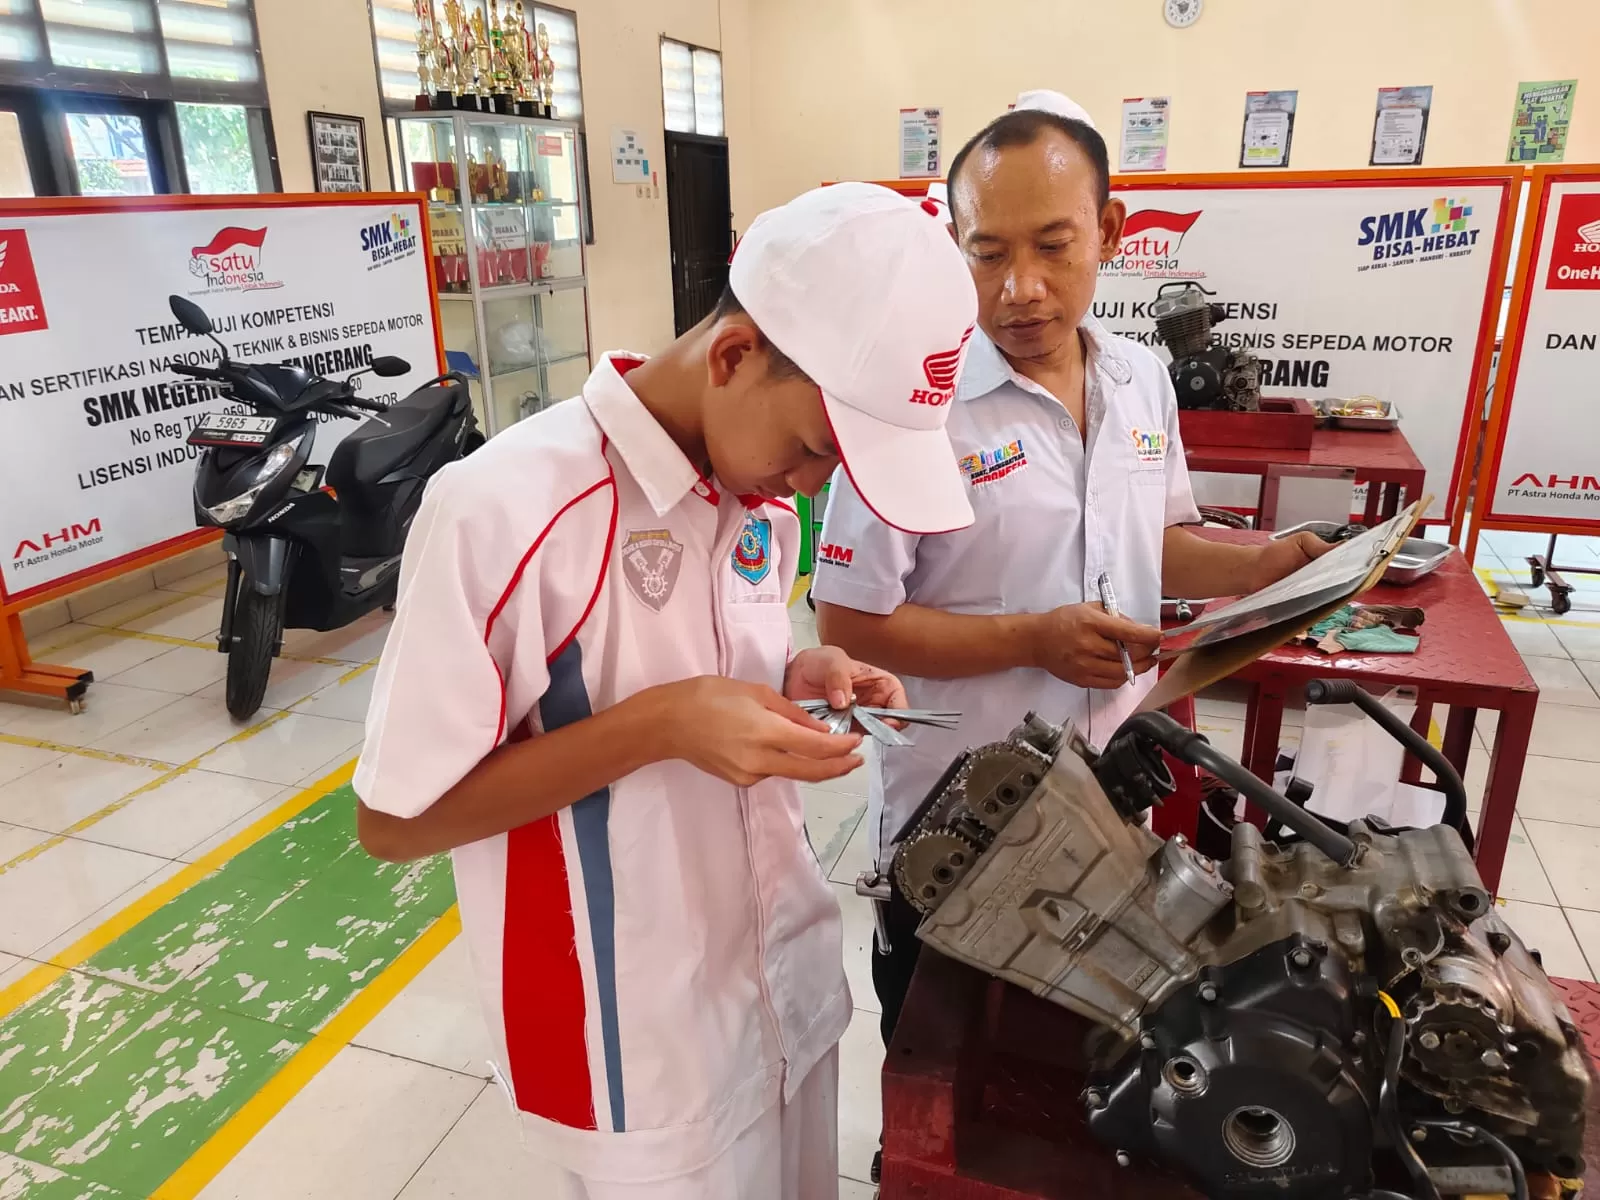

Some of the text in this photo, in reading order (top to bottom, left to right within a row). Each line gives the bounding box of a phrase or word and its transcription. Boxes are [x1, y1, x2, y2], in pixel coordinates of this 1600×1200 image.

[360, 221, 393, 251] SMK
[1357, 207, 1429, 246] SMK
[371, 236, 416, 262] BISA-HEBAT
[1373, 229, 1481, 261] BISA-HEBAT
[210, 252, 255, 273] satu
[204, 272, 264, 287] Indonesia
[1093, 302, 1125, 318] UJI
[136, 302, 335, 346] TEMP UJI KOMPETENSI
[31, 360, 145, 396] SERTIFIKASI
[233, 336, 285, 358] TEKNIK
[287, 335, 298, 348] &
[300, 328, 339, 347] BISNIS
[342, 322, 386, 339] SEPEDA
[387, 313, 424, 331] MOTOR
[1211, 332, 1276, 349] BISNIS
[1282, 333, 1367, 351] SEPEDA
[1372, 335, 1453, 353] MOTOR
[1545, 333, 1597, 351] DAN
[83, 389, 141, 427] SMK
[141, 378, 219, 414] NEGERI
[130, 427, 151, 446] No
[154, 420, 182, 441] Reg
[202, 415, 211, 428] A
[216, 416, 248, 429] 5965
[78, 452, 153, 490] LISENSI
[1507, 488, 1600, 501] PT Astra Honda Mo
[267, 502, 296, 524] HONDA
[14, 517, 102, 560] AHM
[13, 535, 104, 571] PT Astra Honda Motor
